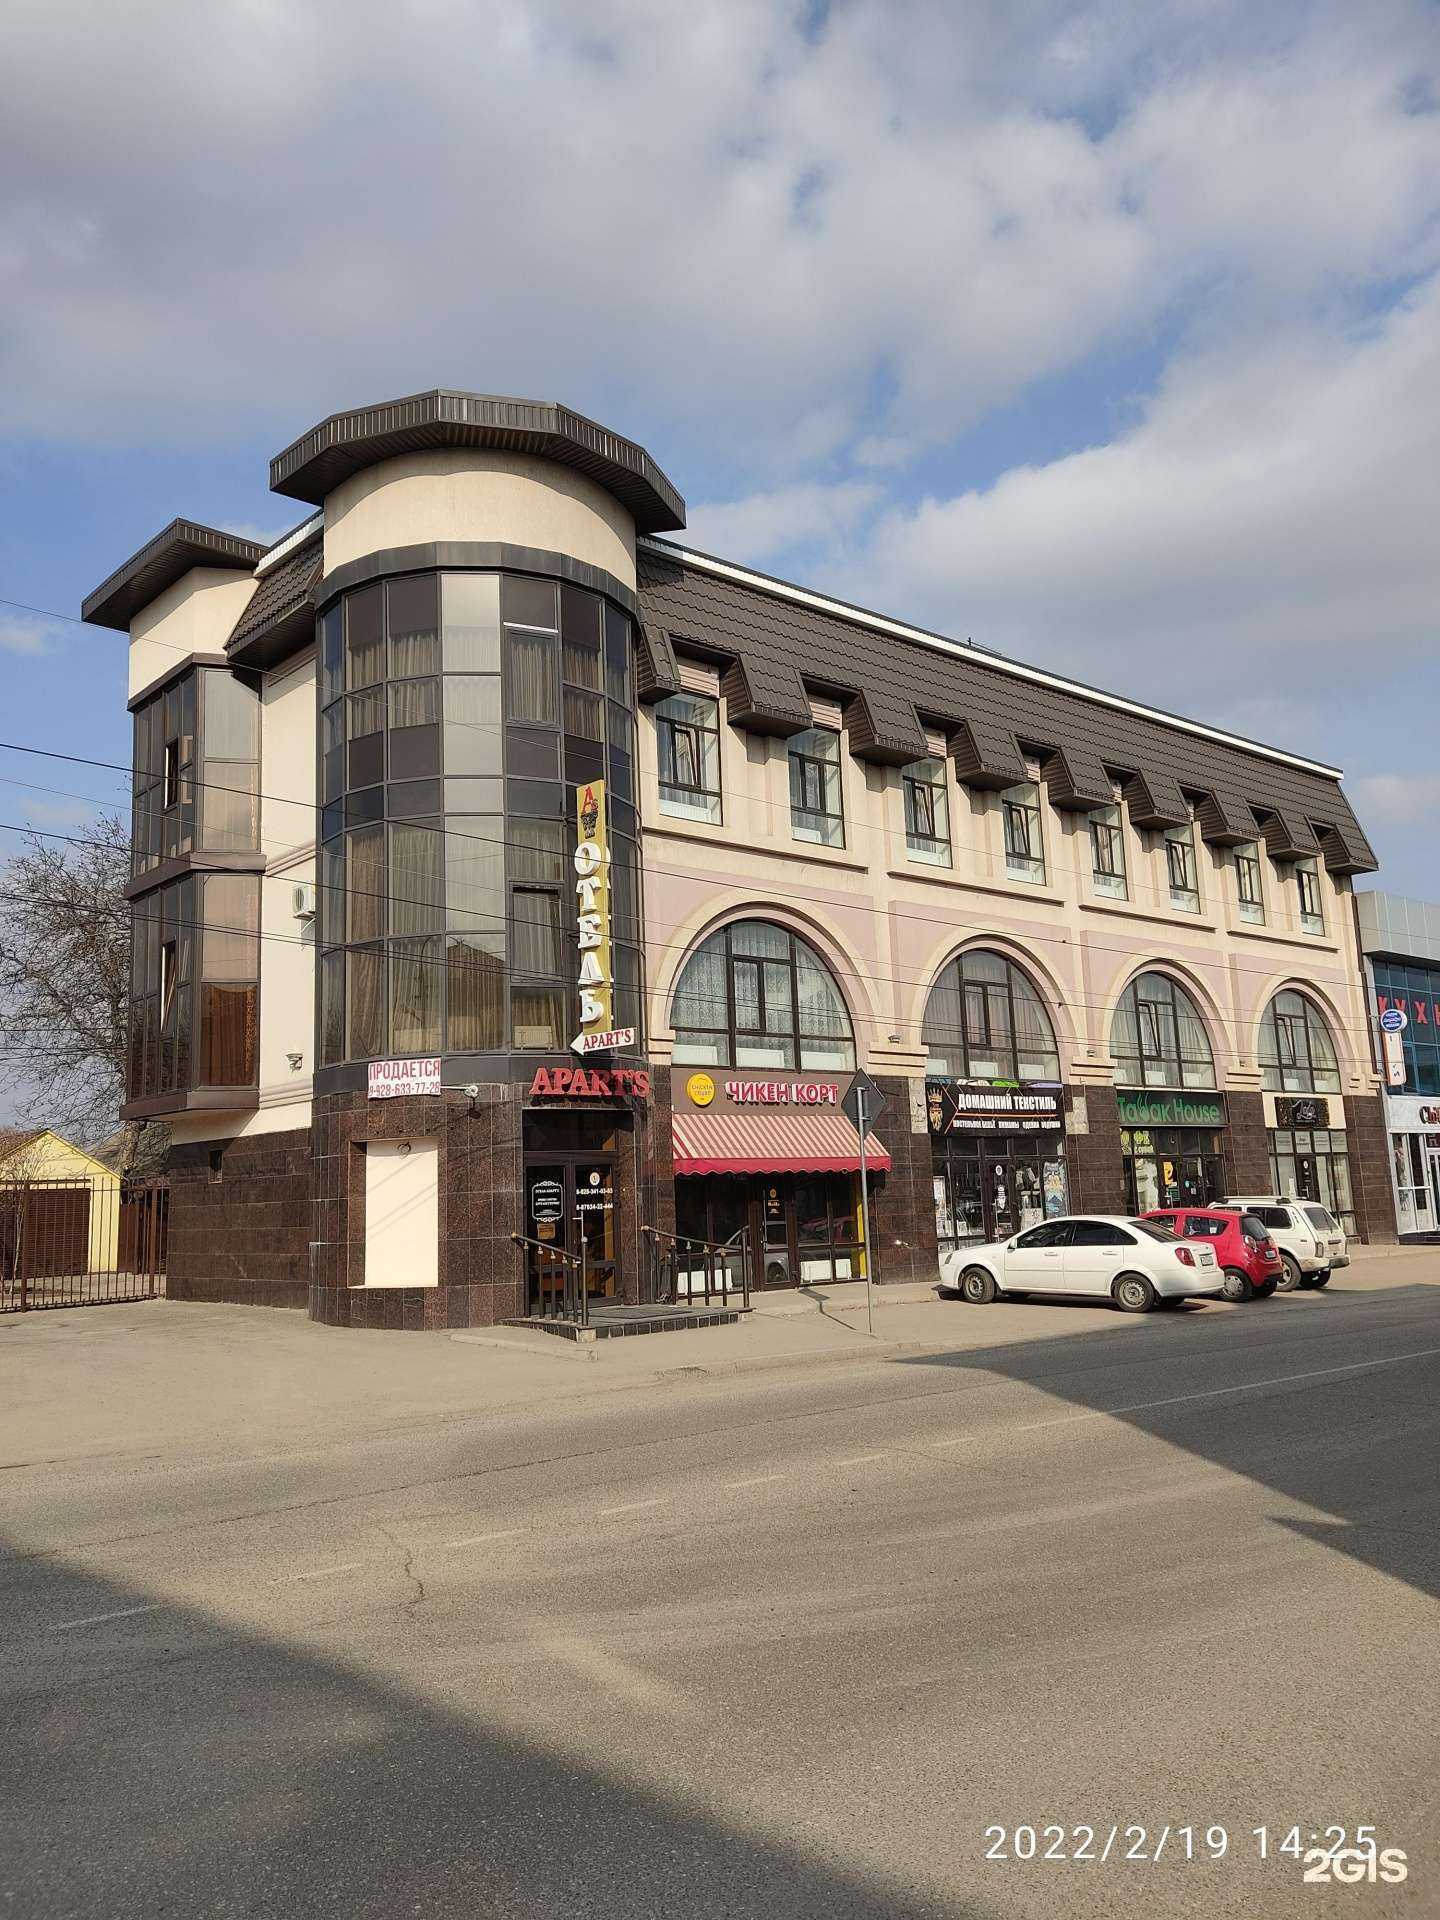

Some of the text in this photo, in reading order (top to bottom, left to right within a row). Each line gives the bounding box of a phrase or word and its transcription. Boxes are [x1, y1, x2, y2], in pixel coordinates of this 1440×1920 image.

[574, 841, 605, 1023] ОТЕЛЬ
[583, 1030, 632, 1050] APART'S
[369, 1060, 441, 1081] ПРОДАЕТСЯ
[529, 1066, 651, 1098] APART'S
[726, 1081, 838, 1104] ЧИКЕН КОРТ
[958, 1093, 1057, 1110] ДОМАШНИЙ ТЕКСТИЛЬ
[1173, 1098, 1221, 1123] House
